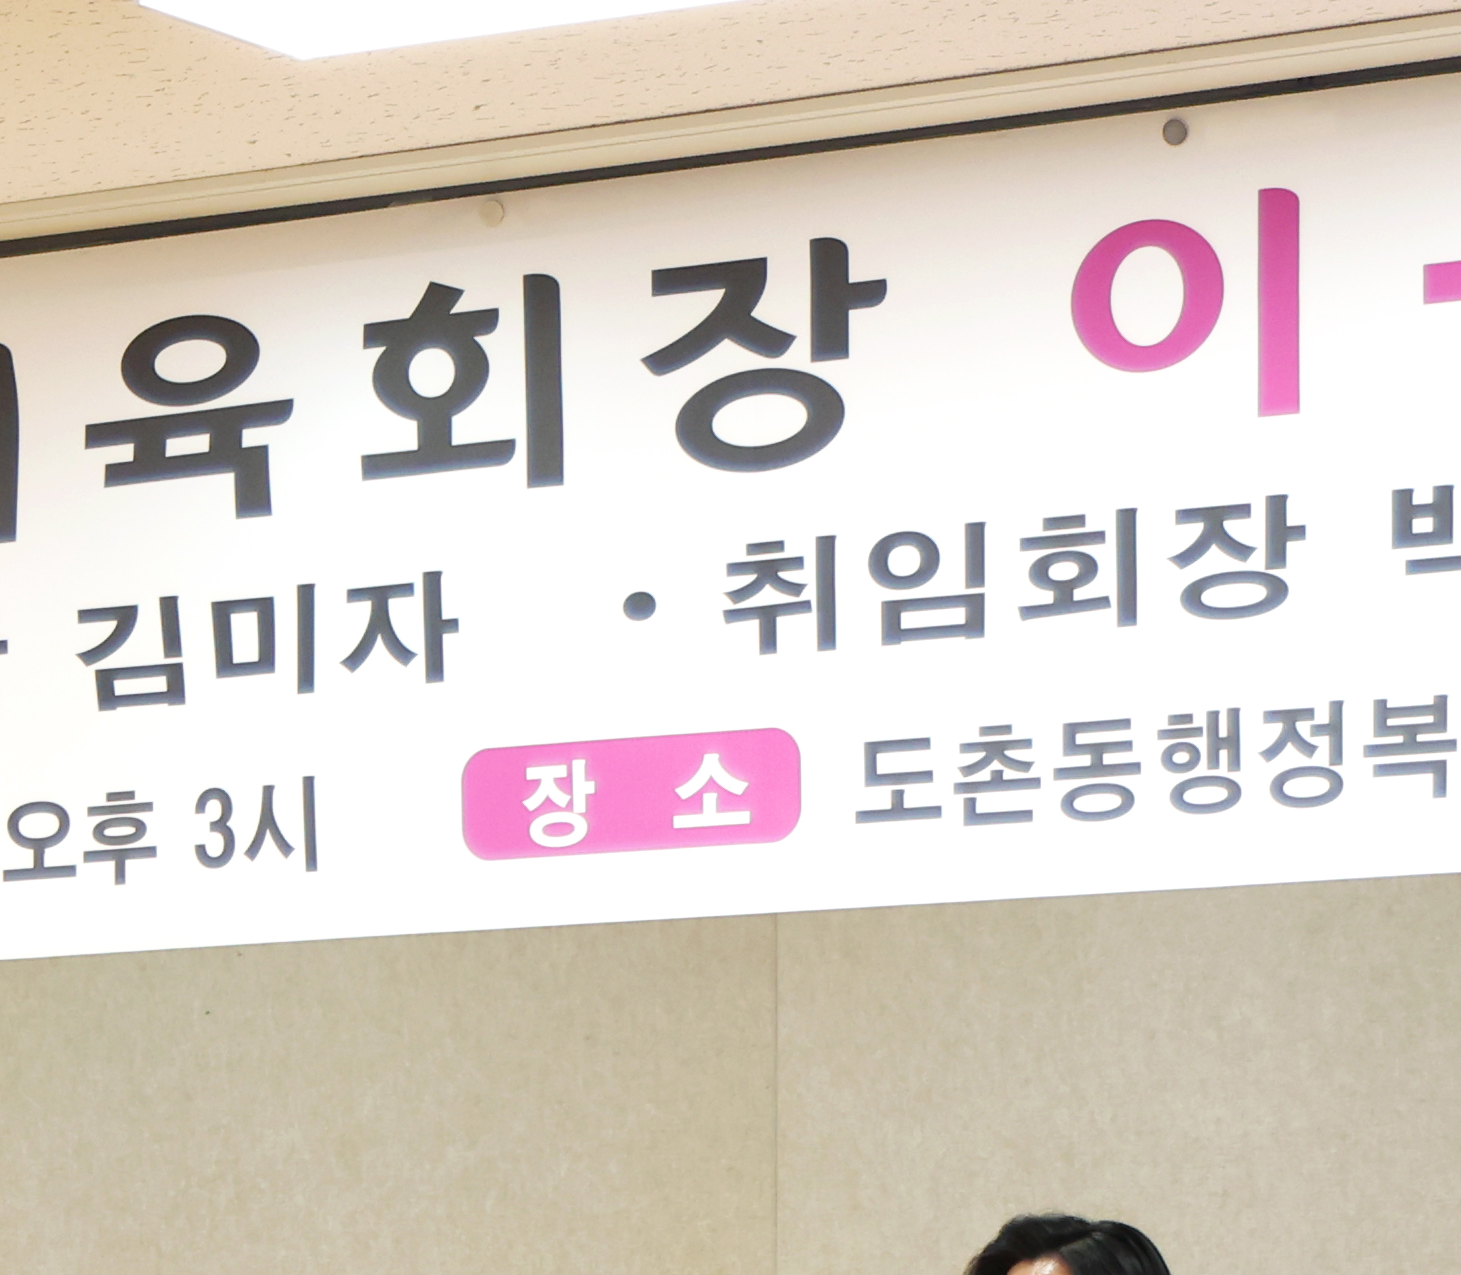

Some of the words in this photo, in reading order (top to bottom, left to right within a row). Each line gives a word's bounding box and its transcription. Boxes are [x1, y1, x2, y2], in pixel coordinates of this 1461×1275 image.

[76, 570, 459, 712] 김미자
[724, 494, 1306, 654] 취임회장
[2, 790, 157, 886] 오후
[194, 775, 319, 873] 3시
